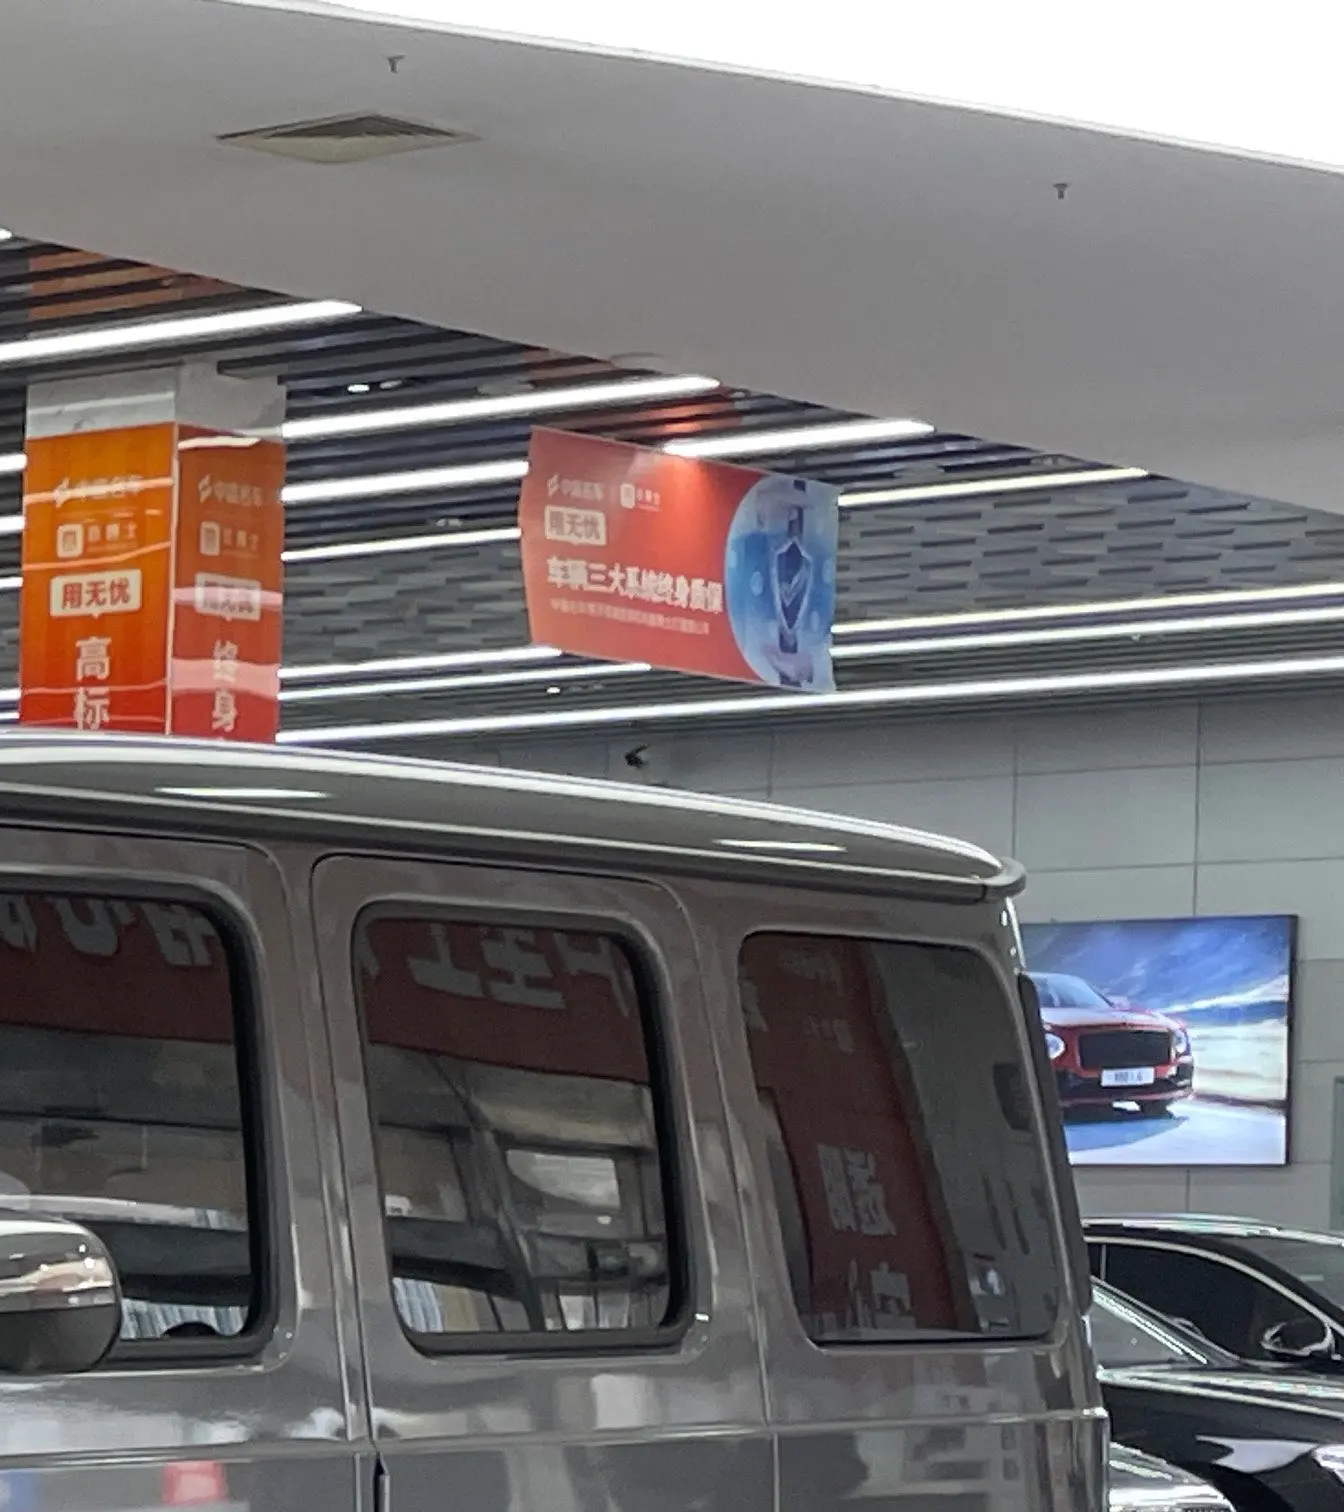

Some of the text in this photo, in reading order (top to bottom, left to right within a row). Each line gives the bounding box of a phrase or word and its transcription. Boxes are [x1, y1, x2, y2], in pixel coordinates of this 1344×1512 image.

[550, 511, 601, 540] 用无忧
[61, 578, 131, 610] 用无忧
